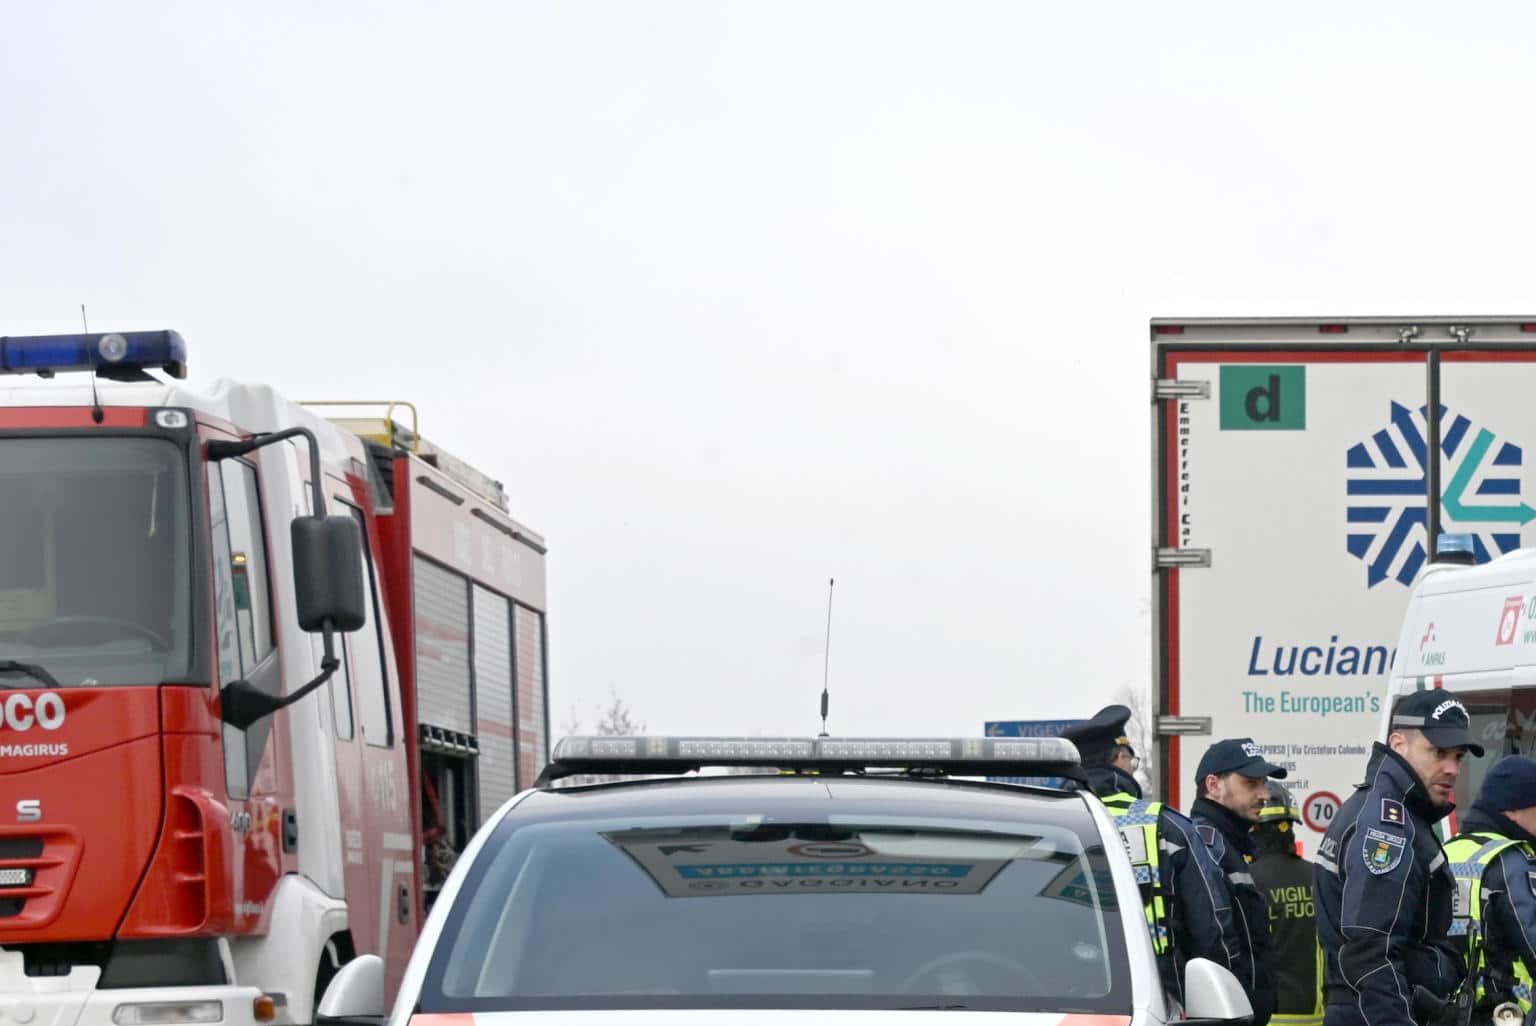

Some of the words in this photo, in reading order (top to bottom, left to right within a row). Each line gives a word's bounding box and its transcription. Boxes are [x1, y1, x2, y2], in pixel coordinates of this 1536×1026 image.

[1245, 374, 1280, 421] d
[1181, 514, 1190, 546] Car
[1242, 691, 1275, 713] The
[0, 743, 68, 756] MAGIRUS
[1314, 804, 1333, 820] 70
[1285, 902, 1315, 919] FUO
